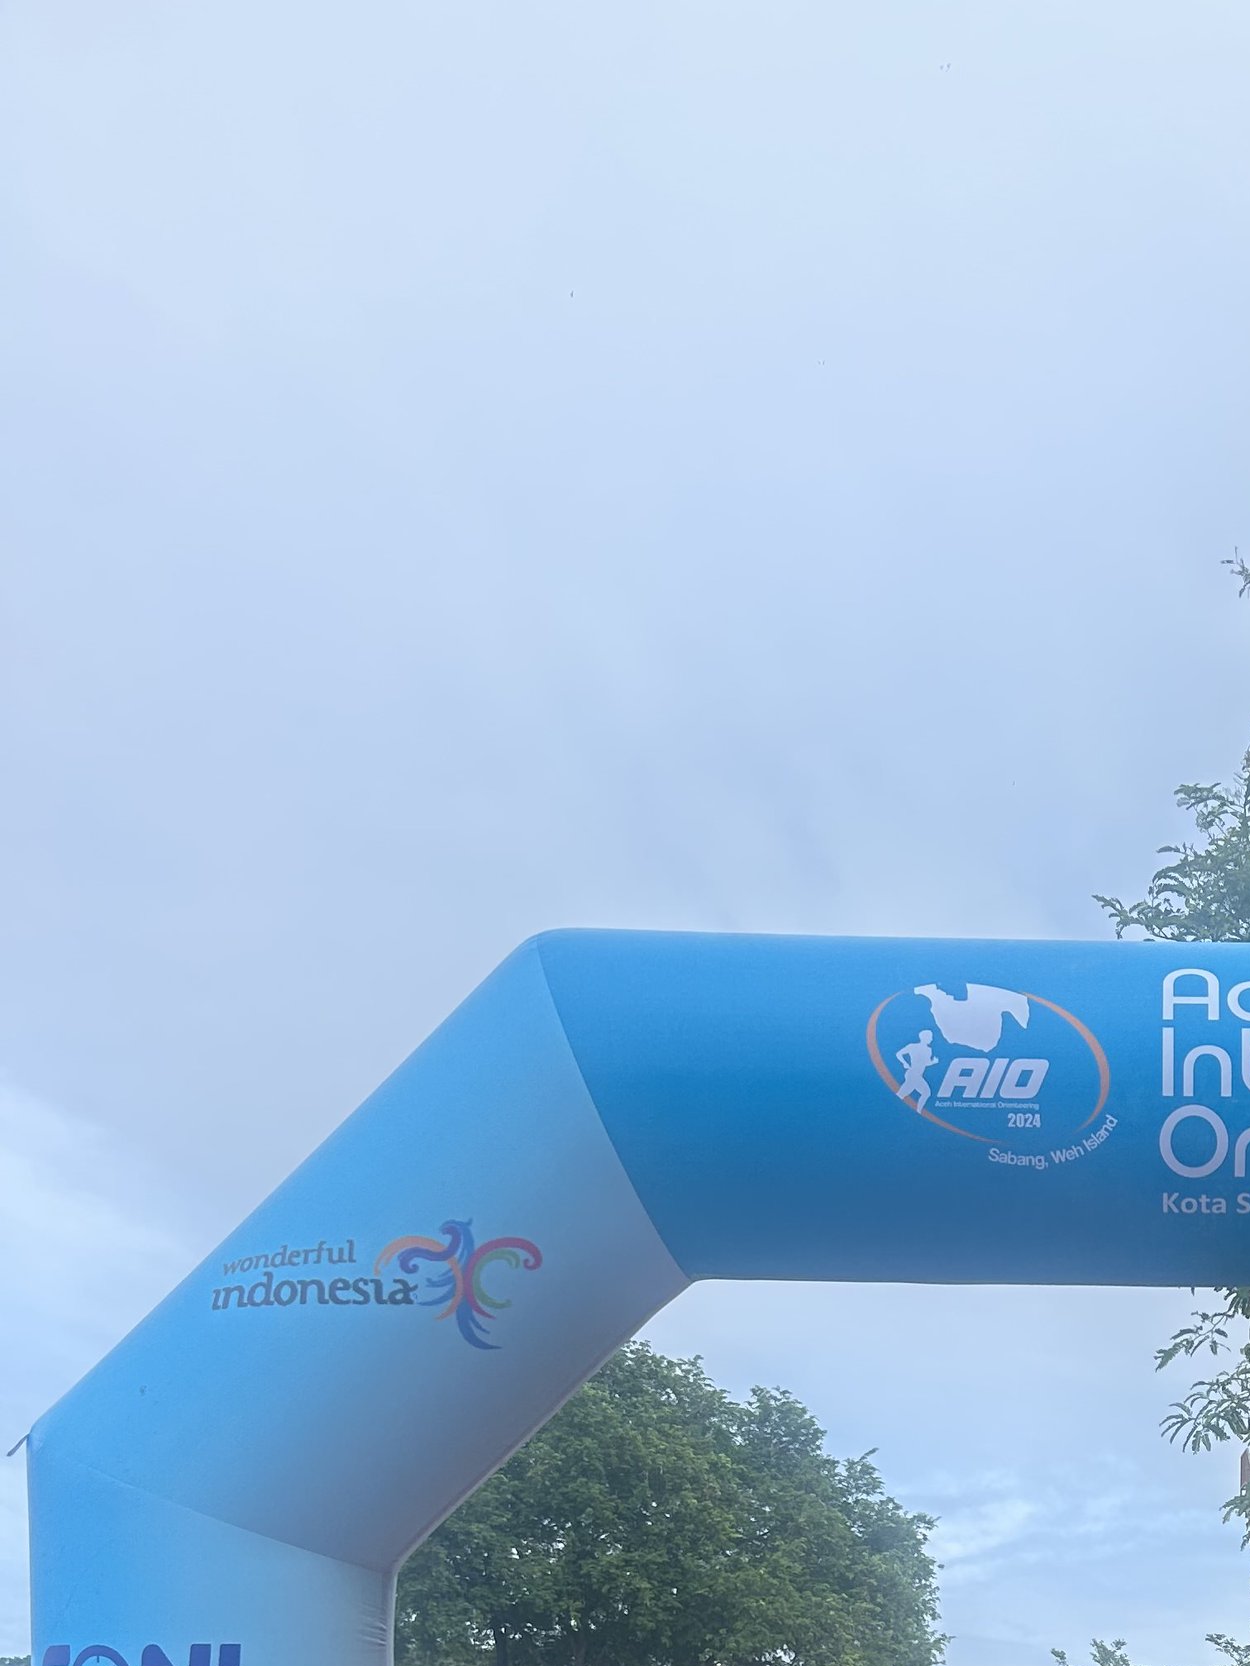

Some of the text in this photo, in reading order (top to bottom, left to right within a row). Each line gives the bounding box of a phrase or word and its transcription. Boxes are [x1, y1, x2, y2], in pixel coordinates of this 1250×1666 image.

[937, 1058, 1050, 1099] AIO
[1007, 1113, 1042, 1128] 2024
[988, 1114, 1119, 1170] Sabang, Weh Island
[1162, 1192, 1227, 1214] Kota
[222, 1240, 356, 1276] wonderful
